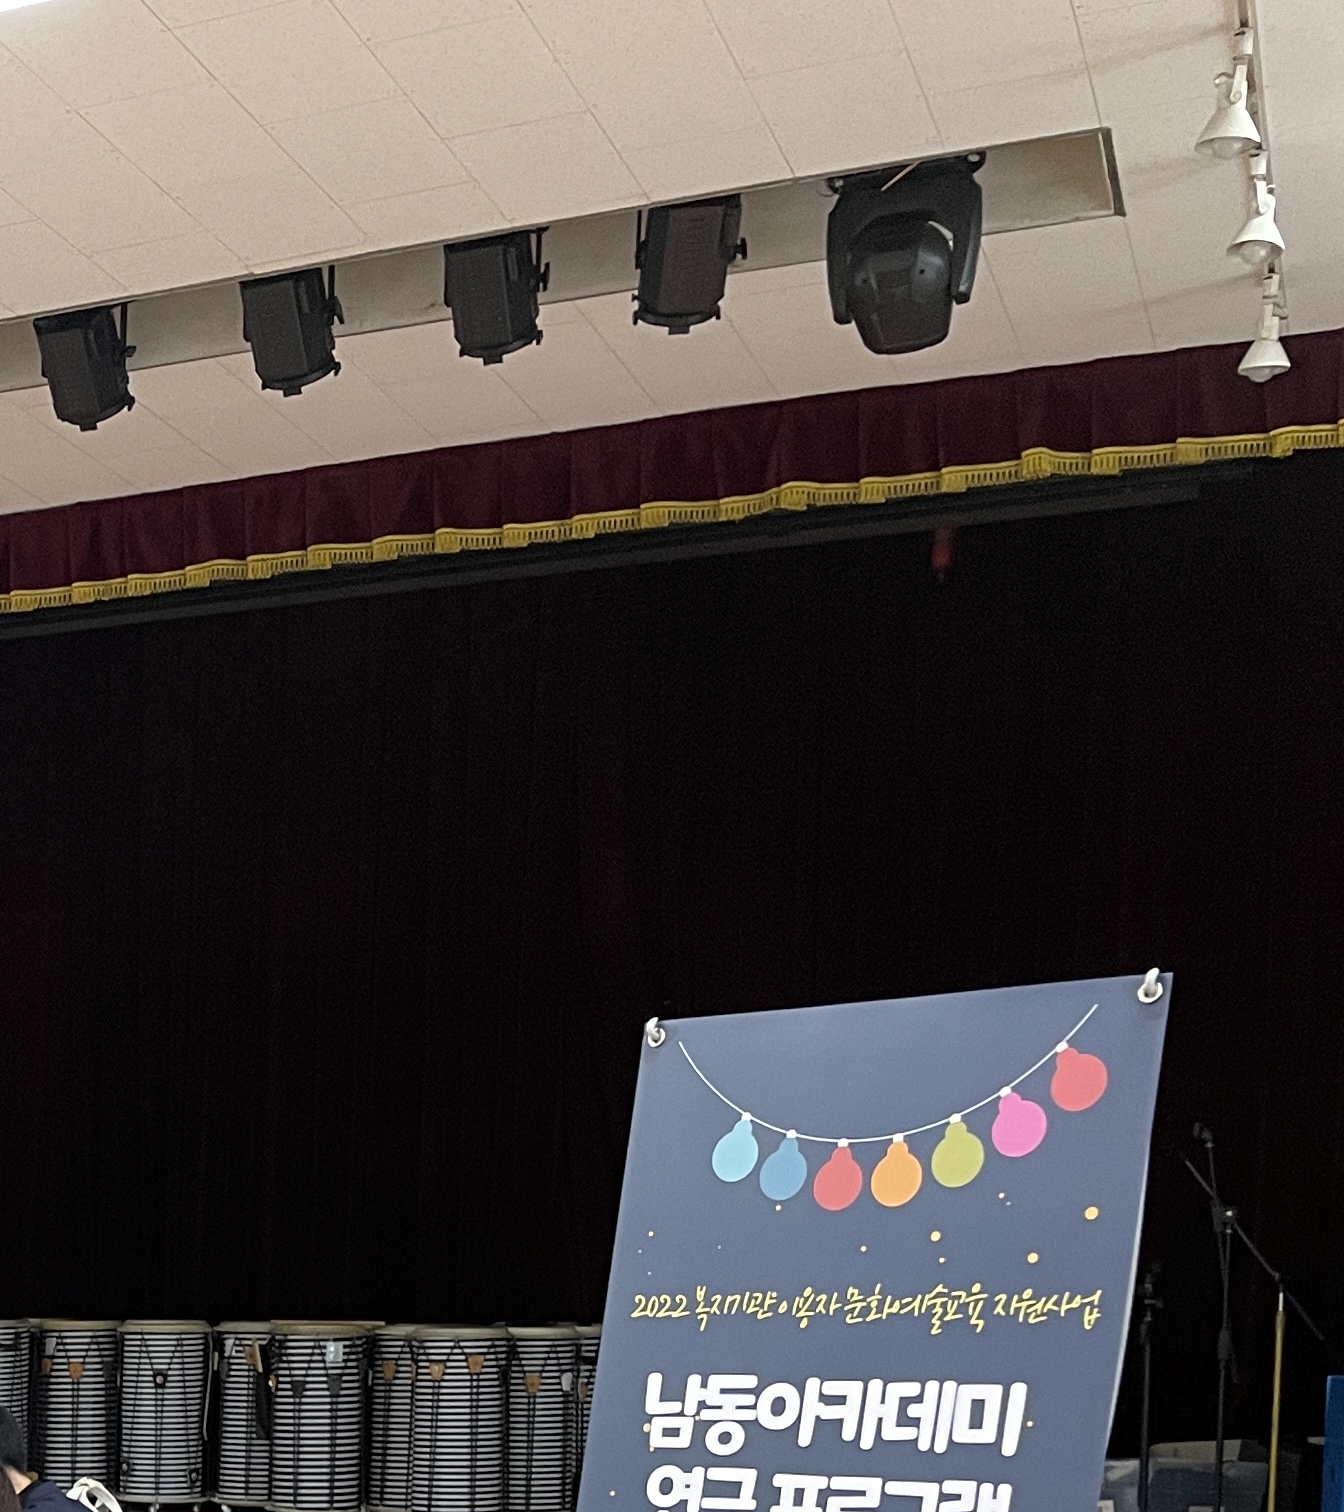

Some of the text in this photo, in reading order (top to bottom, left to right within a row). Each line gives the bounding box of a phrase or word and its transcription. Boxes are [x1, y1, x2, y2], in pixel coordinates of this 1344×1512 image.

[631, 1295, 690, 1317] 2022
[844, 1283, 988, 1334] 문화예술교육
[994, 1289, 1102, 1329] 지원사업
[645, 1373, 1028, 1456] 남동아카데미
